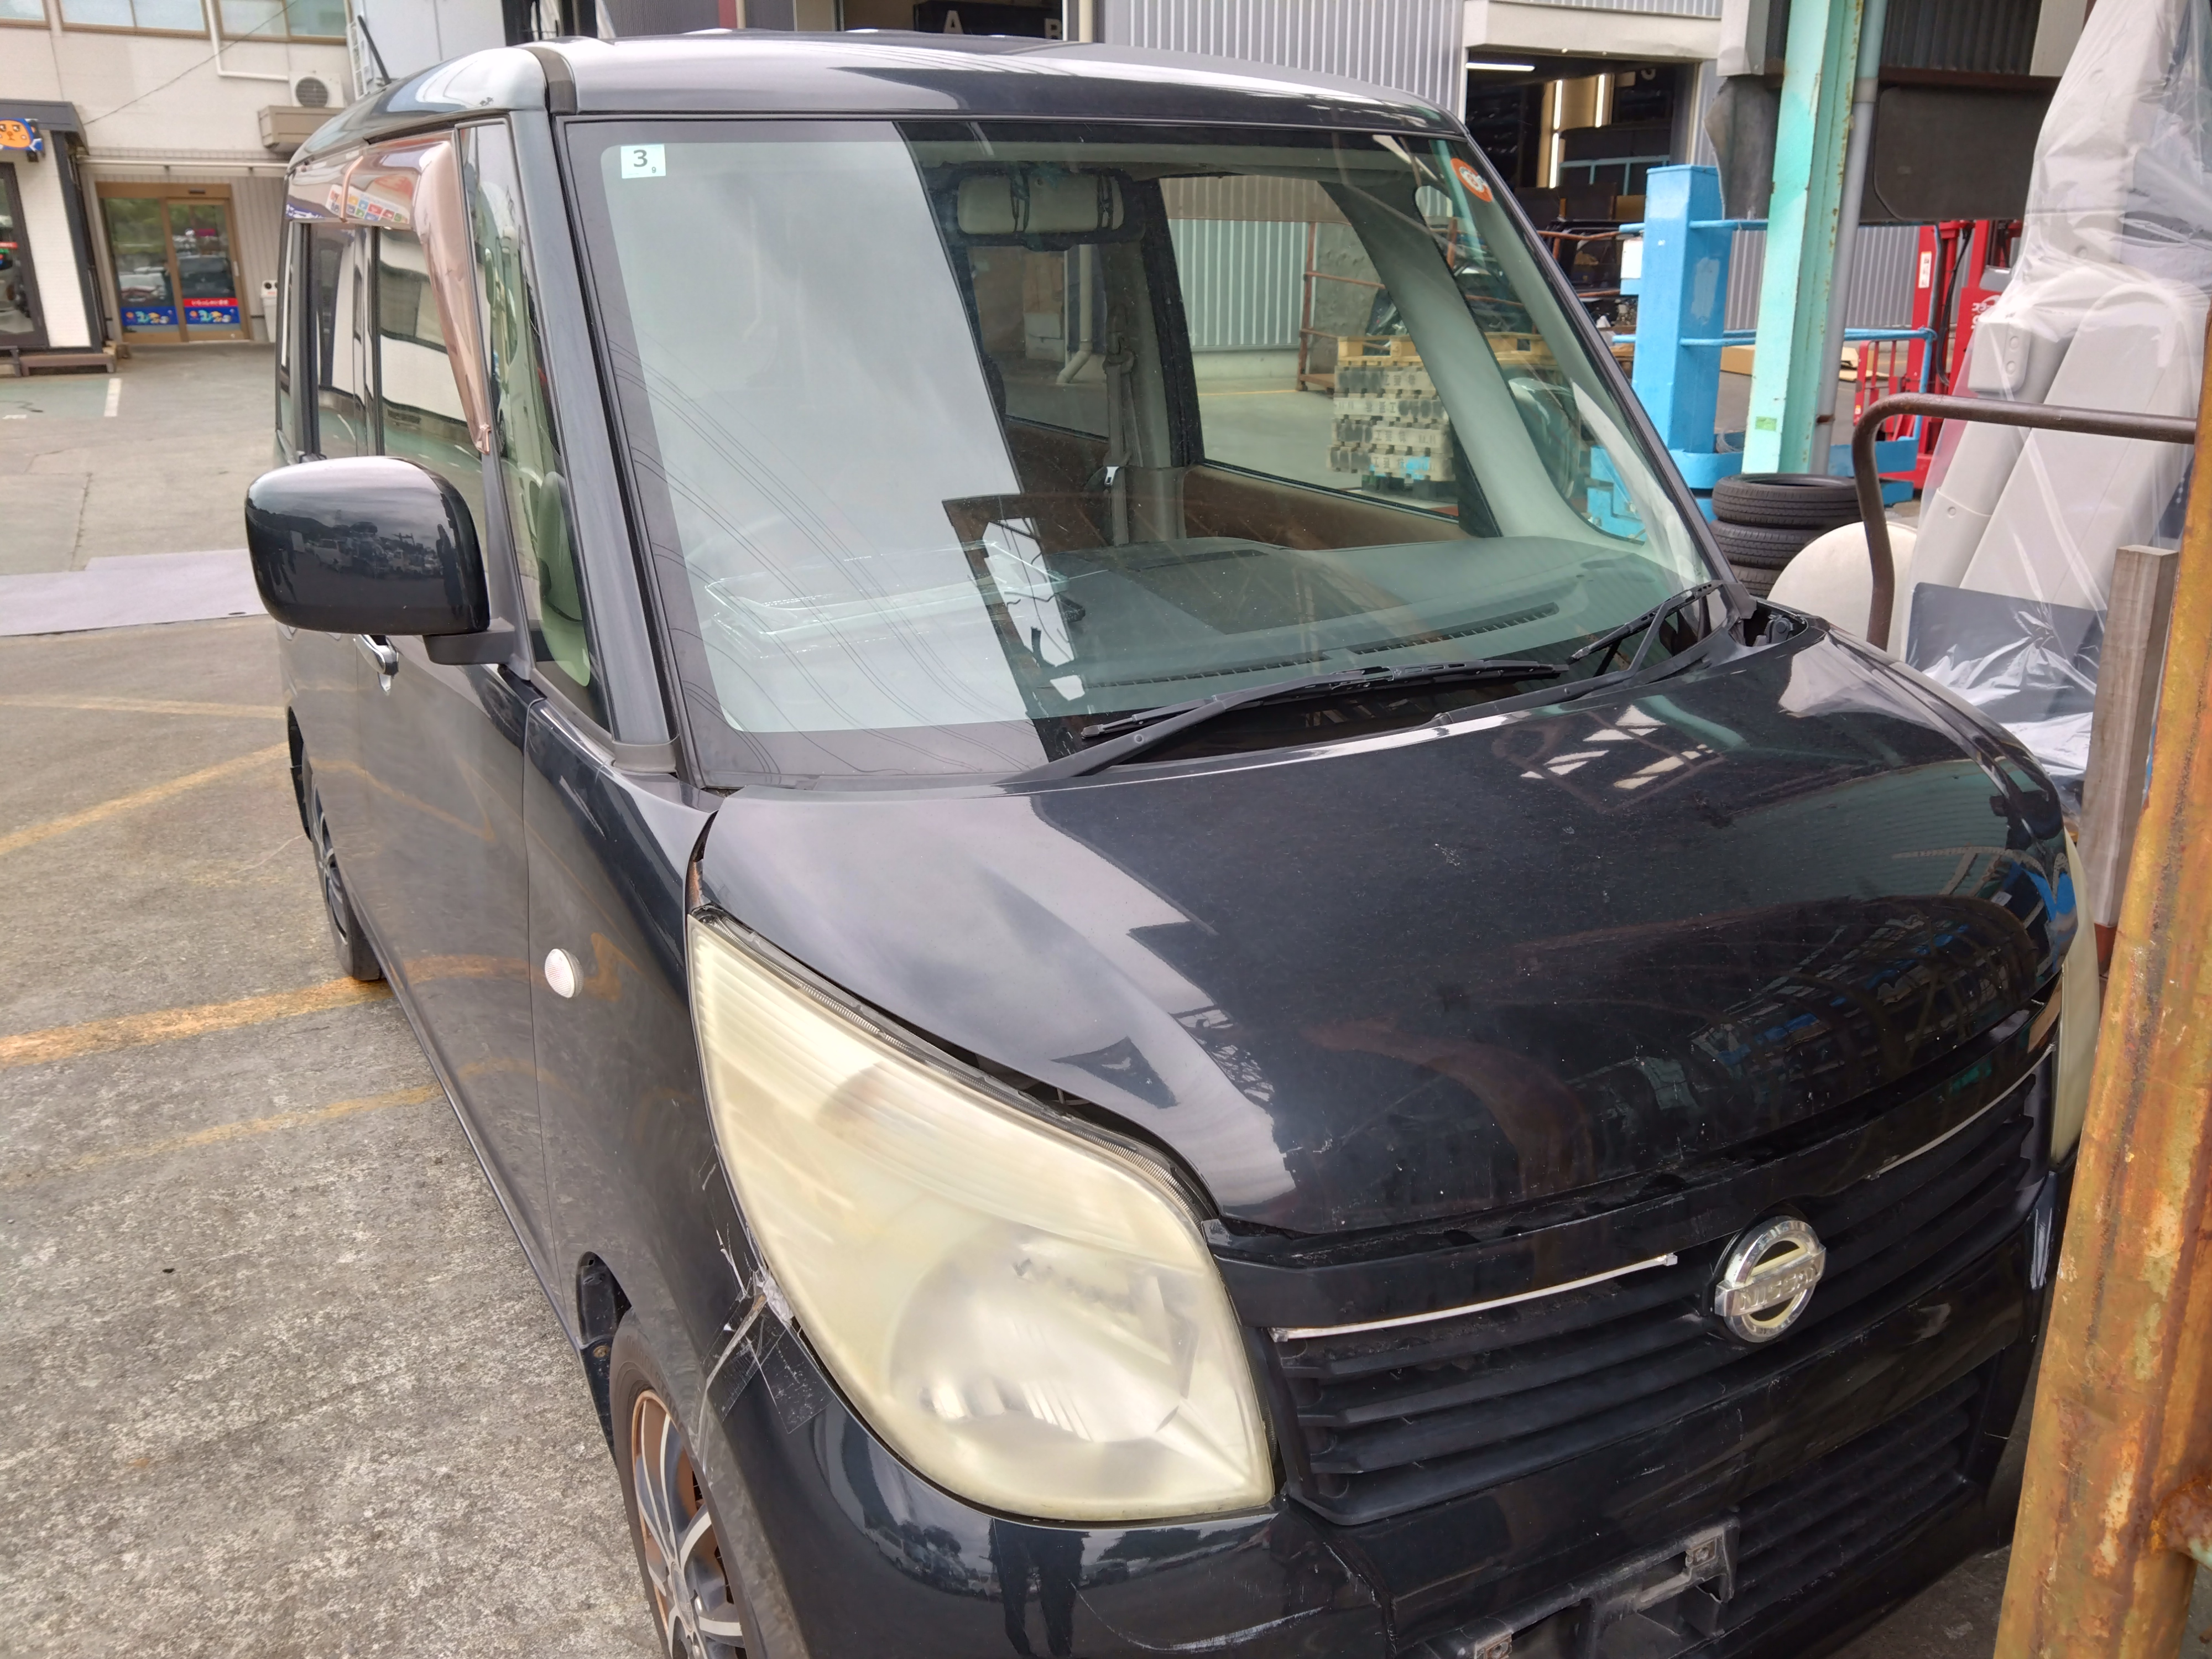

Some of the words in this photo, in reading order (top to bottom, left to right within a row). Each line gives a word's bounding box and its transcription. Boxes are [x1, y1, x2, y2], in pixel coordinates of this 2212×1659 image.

[943, 9, 964, 34] A
[1044, 18, 1062, 39] B
[633, 149, 648, 168] 3
[1739, 1259, 1820, 1311] NISSAN
